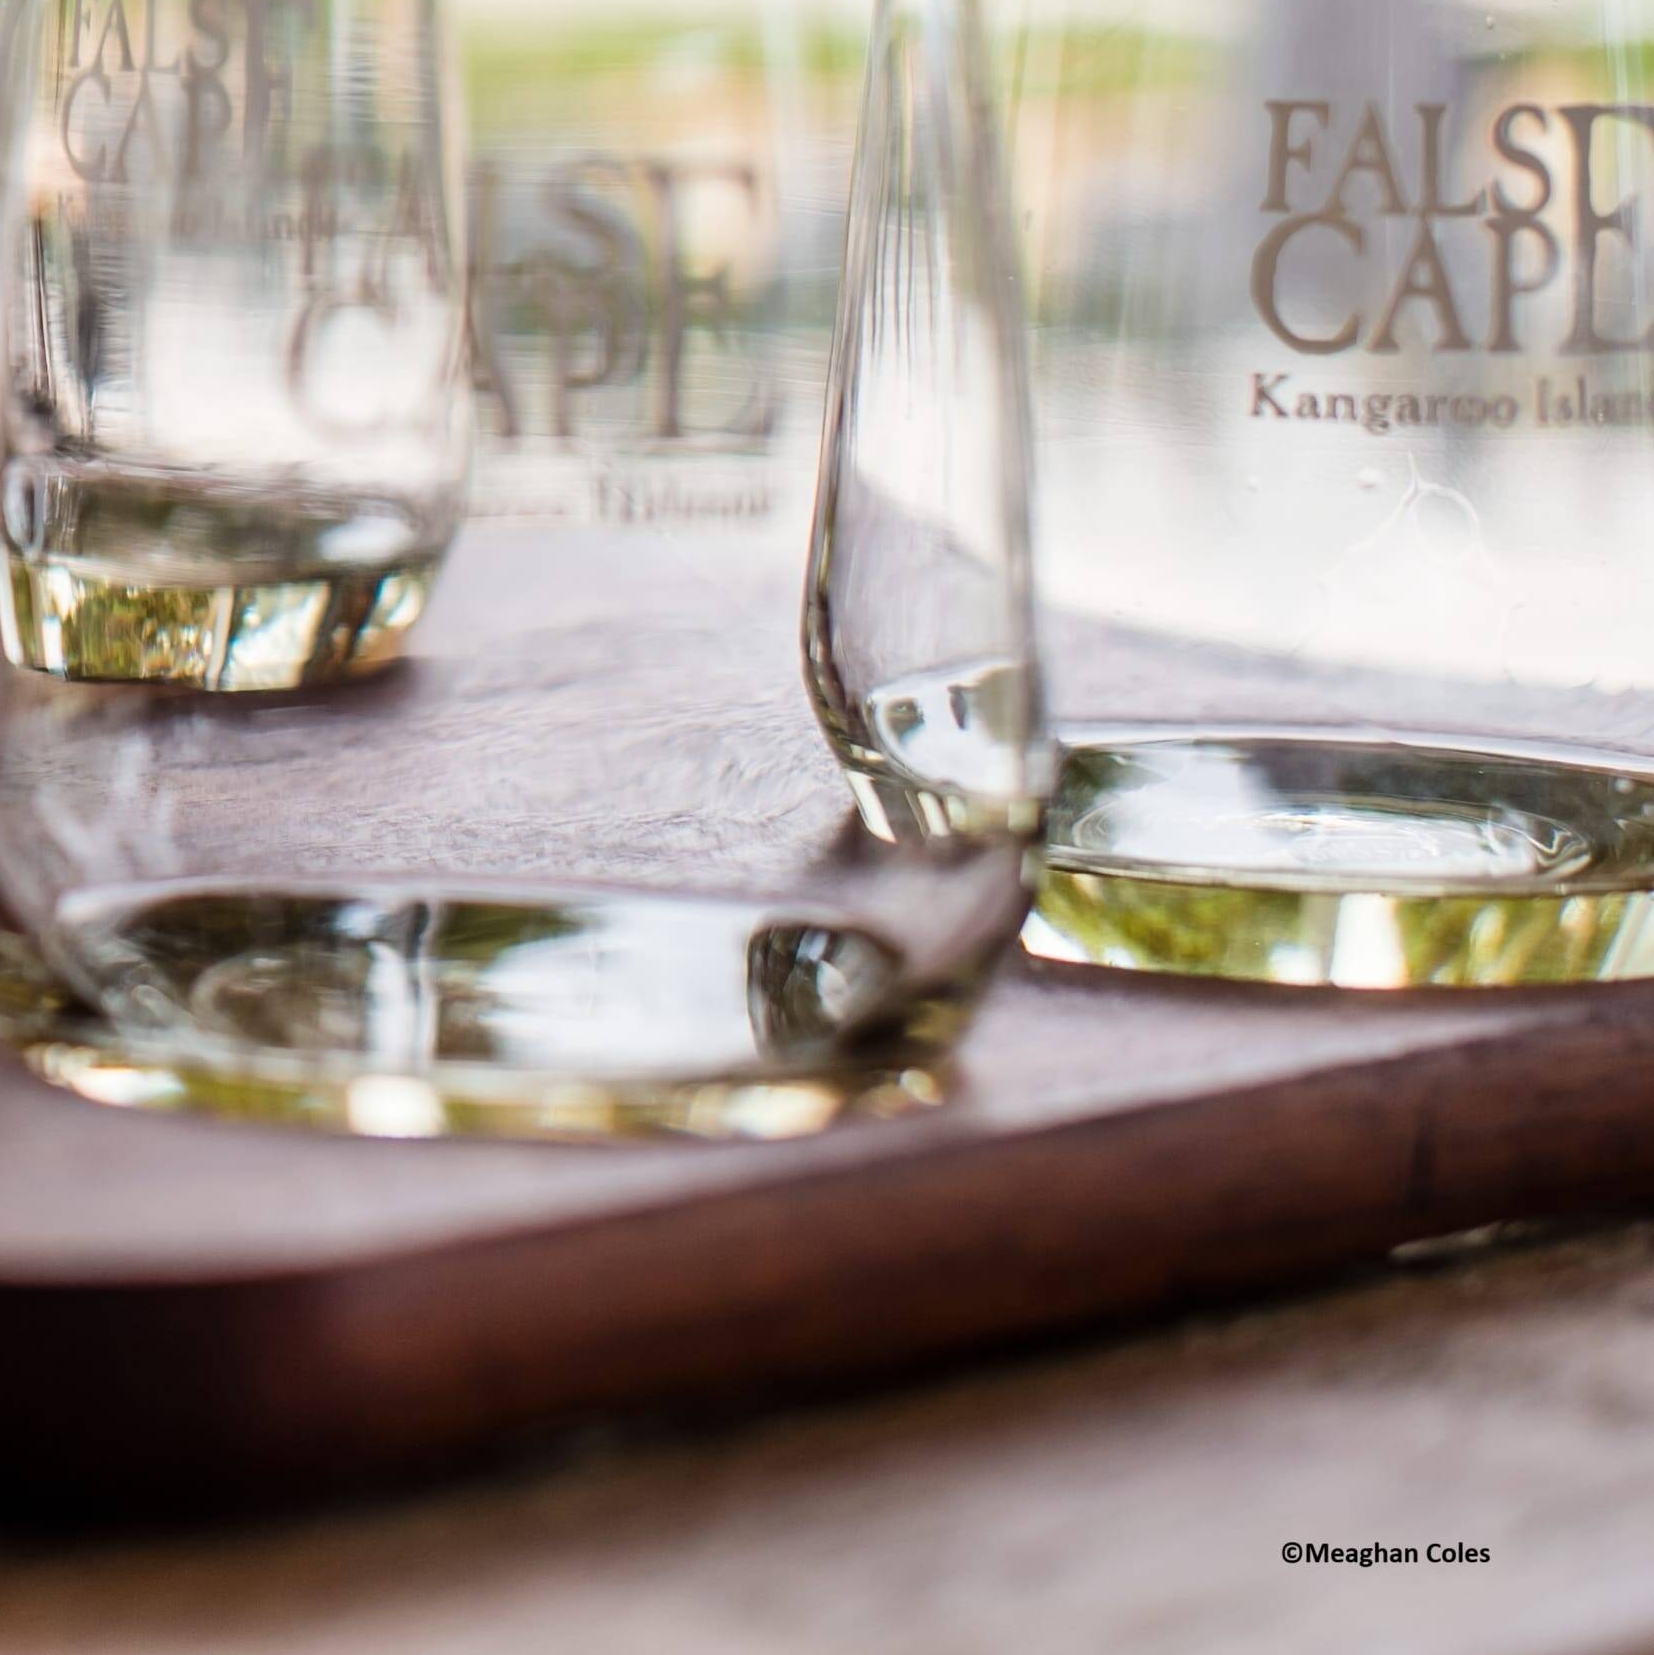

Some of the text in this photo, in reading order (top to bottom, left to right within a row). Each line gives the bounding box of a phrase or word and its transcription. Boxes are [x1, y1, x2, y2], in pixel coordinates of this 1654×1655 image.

[1259, 98, 1654, 217] FALSE
[1249, 211, 1654, 358] CAPE
[1248, 371, 1654, 435] Kangaroo Islan
